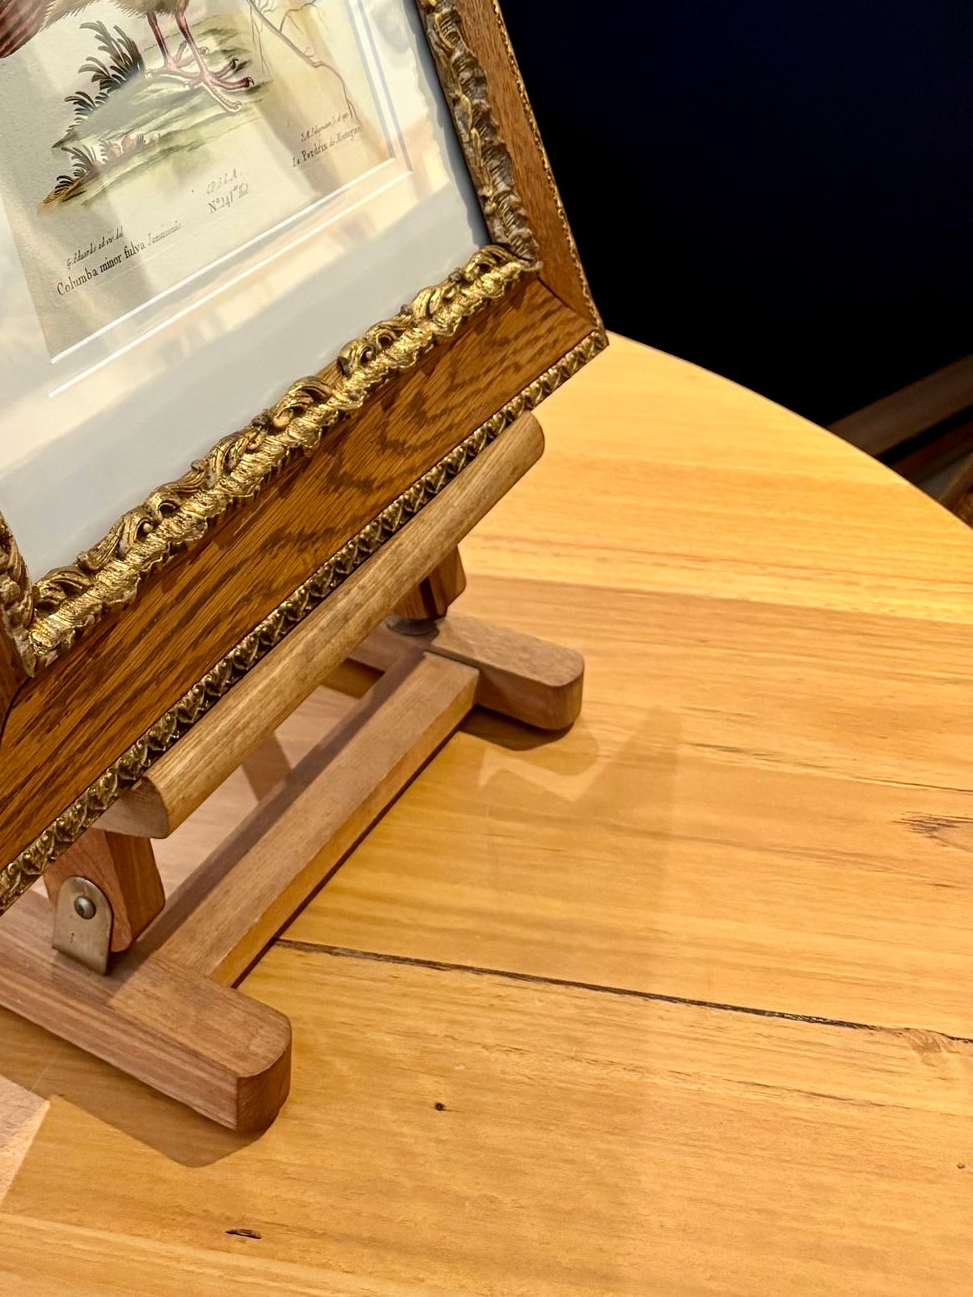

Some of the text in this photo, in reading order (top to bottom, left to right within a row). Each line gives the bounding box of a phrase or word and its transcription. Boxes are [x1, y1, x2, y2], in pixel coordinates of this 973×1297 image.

[56, 267, 98, 296] Columba
[99, 254, 122, 273] minor
[124, 241, 146, 259] fulva
